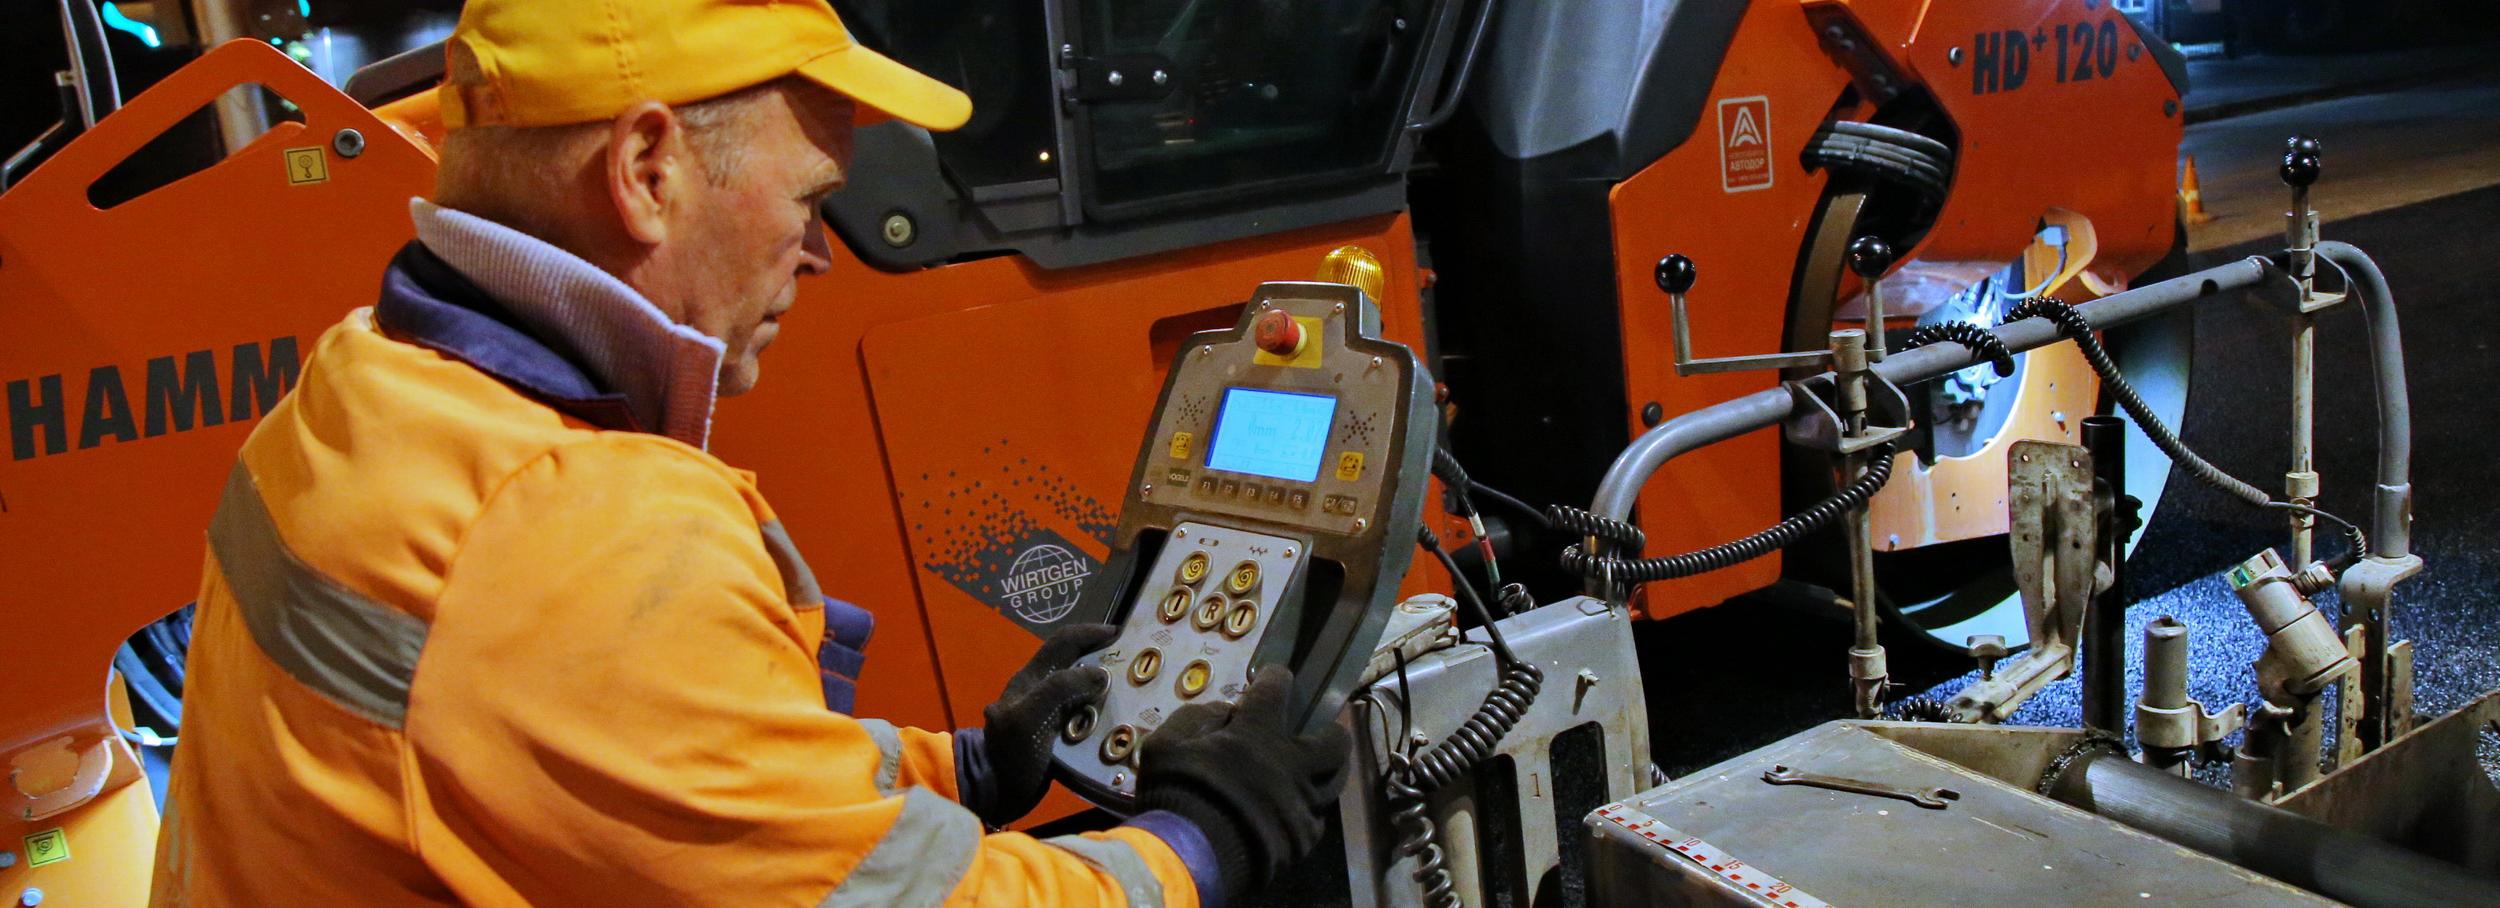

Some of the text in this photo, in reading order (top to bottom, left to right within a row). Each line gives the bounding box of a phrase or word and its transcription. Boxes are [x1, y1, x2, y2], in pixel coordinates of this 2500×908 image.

[1973, 19, 2118, 95] HD+ 120
[6, 335, 300, 461] HAMM
[1001, 557, 1087, 593] WIRTGEN
[1010, 578, 1083, 609] GROUP
[1683, 836, 1702, 847] 10
[1724, 859, 1744, 870] 15
[1768, 882, 1793, 894] 20
